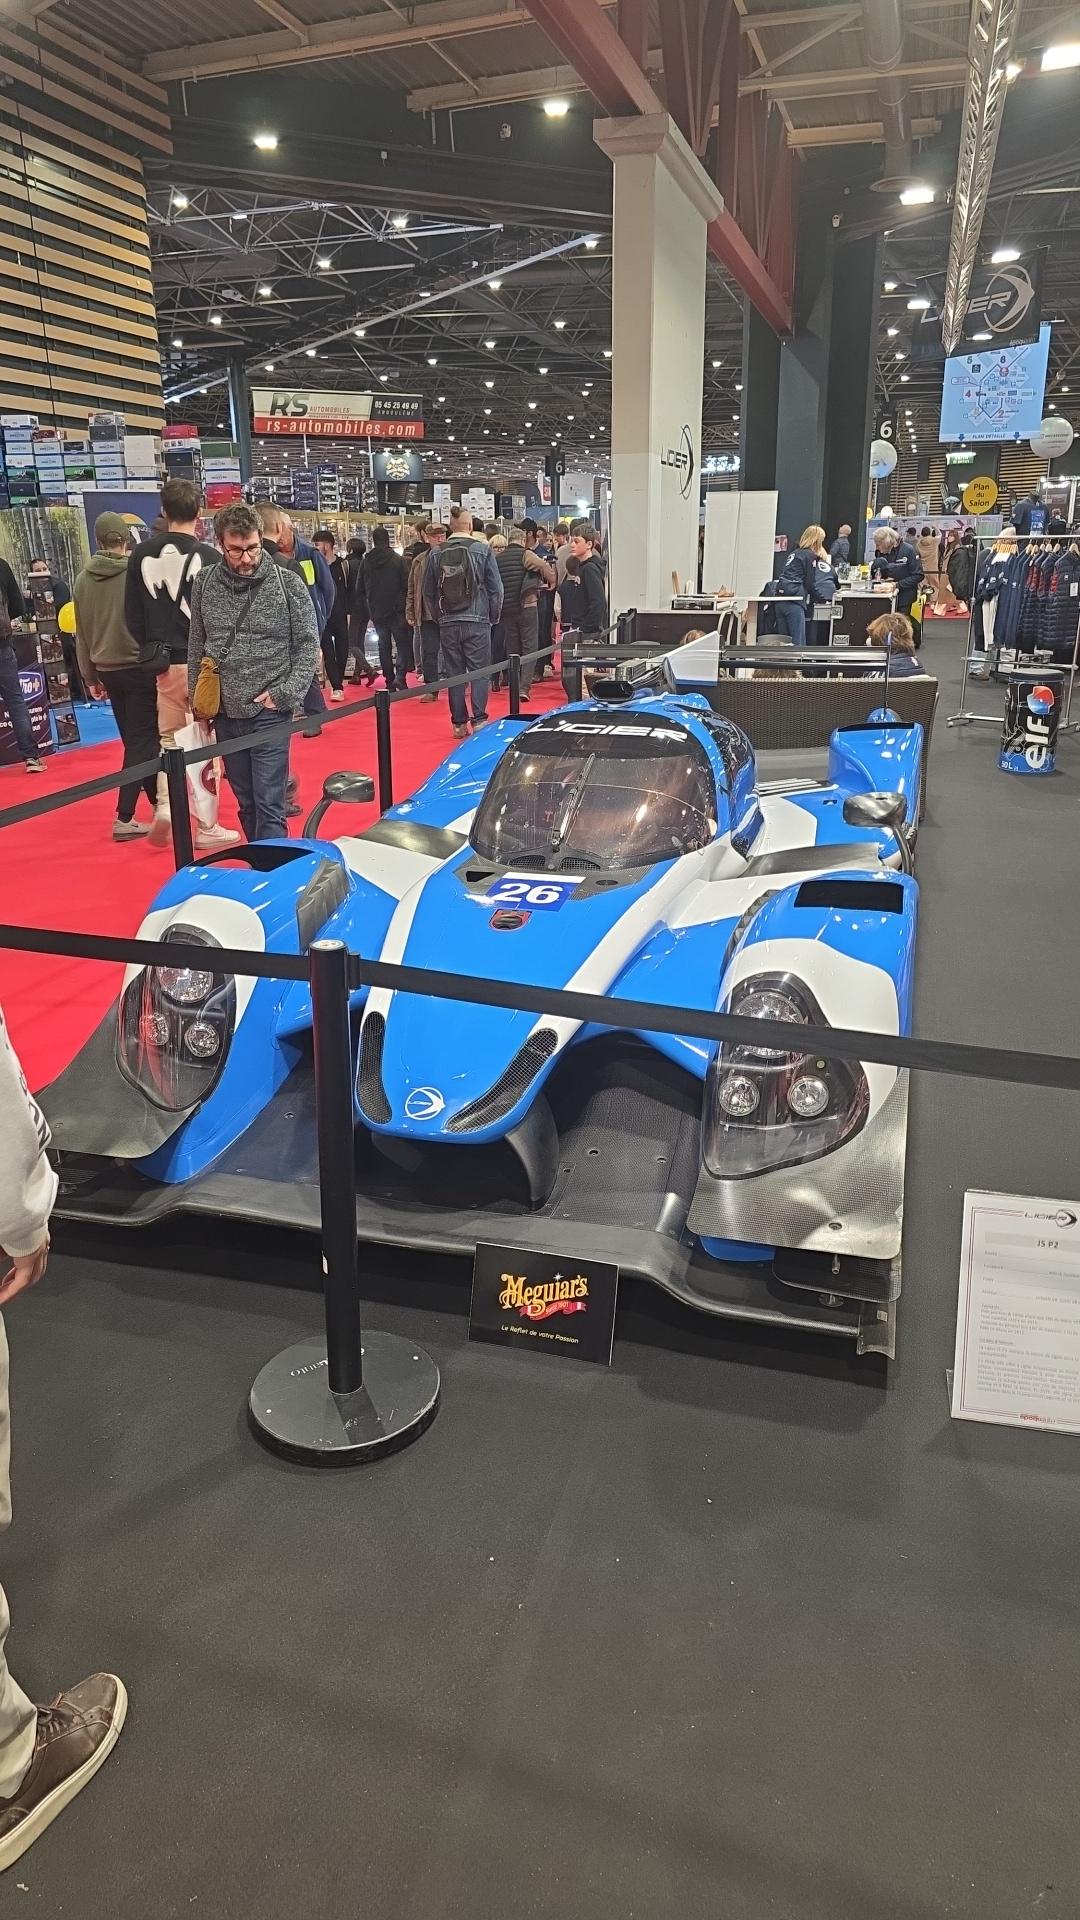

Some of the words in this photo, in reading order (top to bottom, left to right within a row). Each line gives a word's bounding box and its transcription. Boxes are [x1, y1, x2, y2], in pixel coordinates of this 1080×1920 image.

[269, 392, 310, 417] RS
[309, 406, 350, 414] AUTOMOBILES
[374, 401, 382, 409] 05
[383, 401, 391, 409] 45
[410, 402, 419, 410] 49
[266, 419, 416, 436] rs-automobiles.com
[880, 420, 893, 439] 6
[555, 461, 563, 473] 6
[973, 483, 990, 491] Plan
[968, 499, 990, 507] Salon
[526, 721, 688, 743] LIGIER
[1025, 715, 1050, 769] elf
[492, 882, 564, 904] 26
[499, 1273, 588, 1317] Meguiar's
[510, 1326, 529, 1334] Reflet
[538, 1332, 555, 1340] votre
[555, 1334, 579, 1345] Passion
